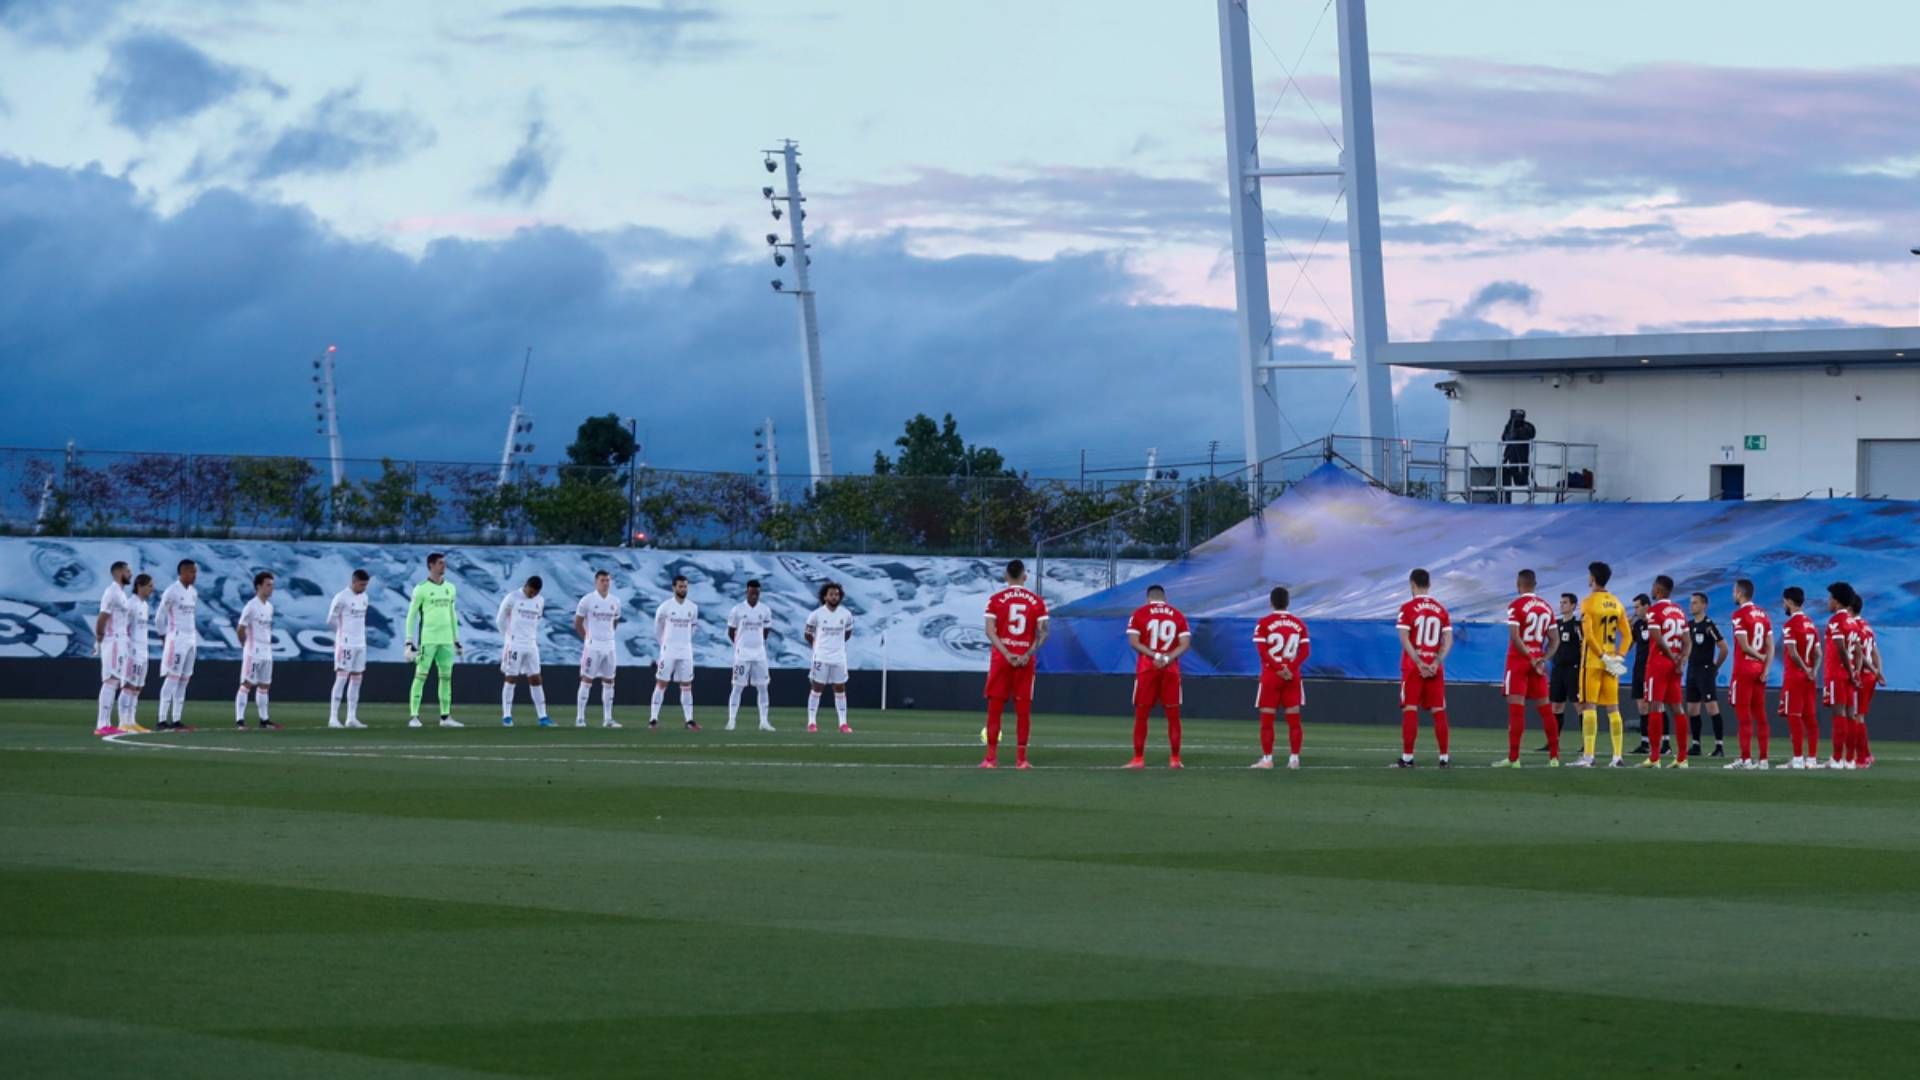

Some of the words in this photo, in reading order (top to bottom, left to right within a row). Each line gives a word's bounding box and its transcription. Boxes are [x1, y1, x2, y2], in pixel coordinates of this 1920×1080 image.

[1008, 603, 1027, 635] 5
[1414, 615, 1441, 647] 10
[1523, 612, 1551, 642] 20
[1600, 615, 1618, 644] 13
[1662, 617, 1686, 647] 25
[1147, 618, 1176, 651] 19
[1267, 633, 1300, 664] 24
[1752, 621, 1764, 650] 8
[1805, 633, 1815, 663] 7
[175, 654, 183, 664] 3
[342, 649, 352, 660] 15
[733, 664, 745, 676] 20
